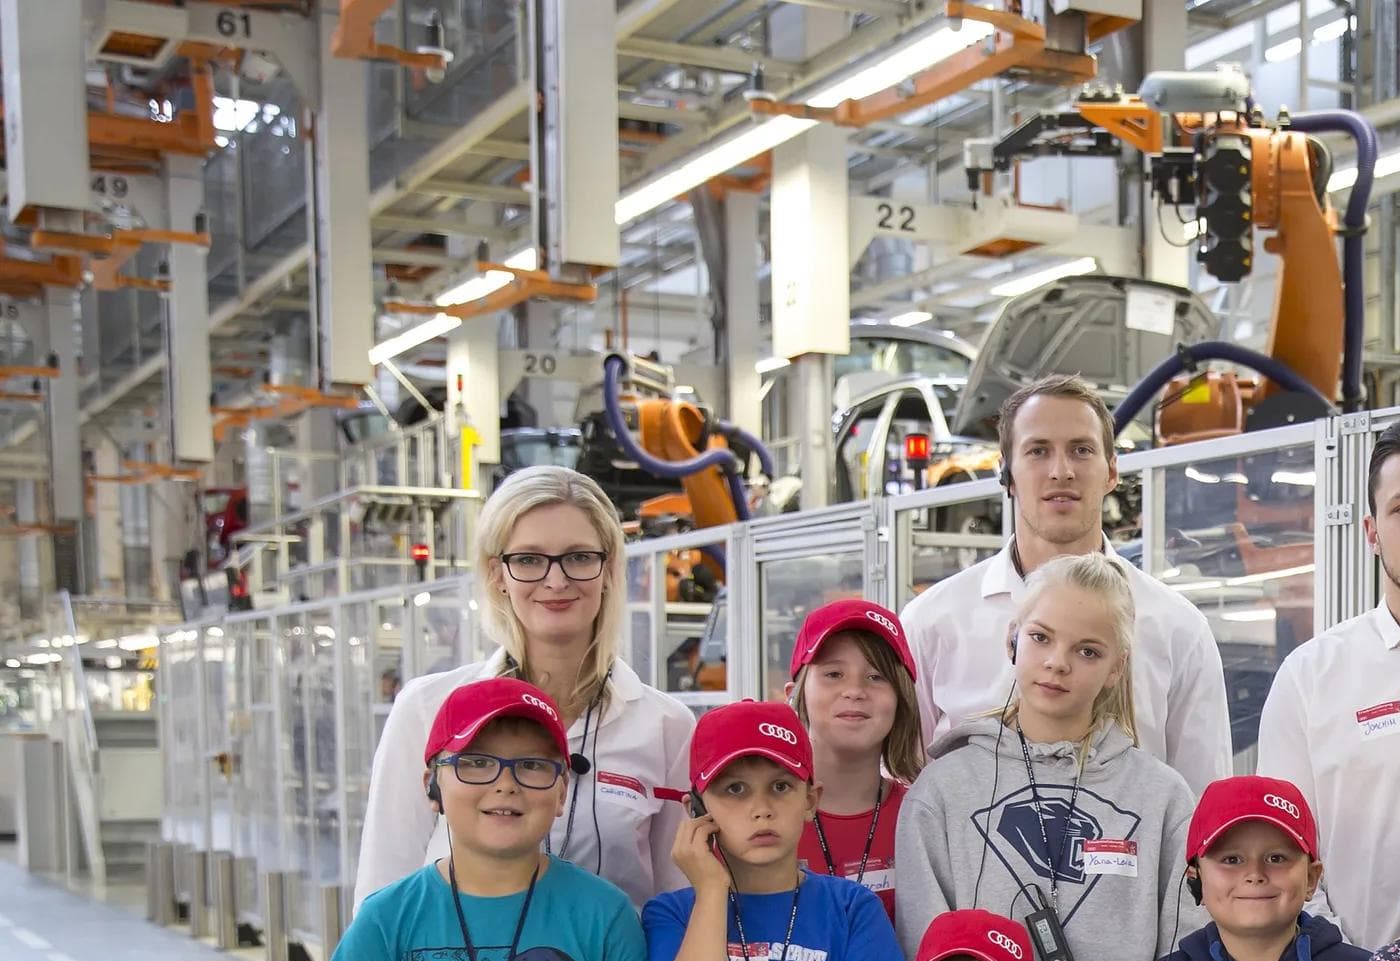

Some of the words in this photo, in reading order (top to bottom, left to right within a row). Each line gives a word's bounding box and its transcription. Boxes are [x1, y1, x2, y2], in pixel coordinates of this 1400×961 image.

[216, 11, 252, 38] 61
[877, 202, 917, 233] 22
[524, 354, 557, 375] 20
